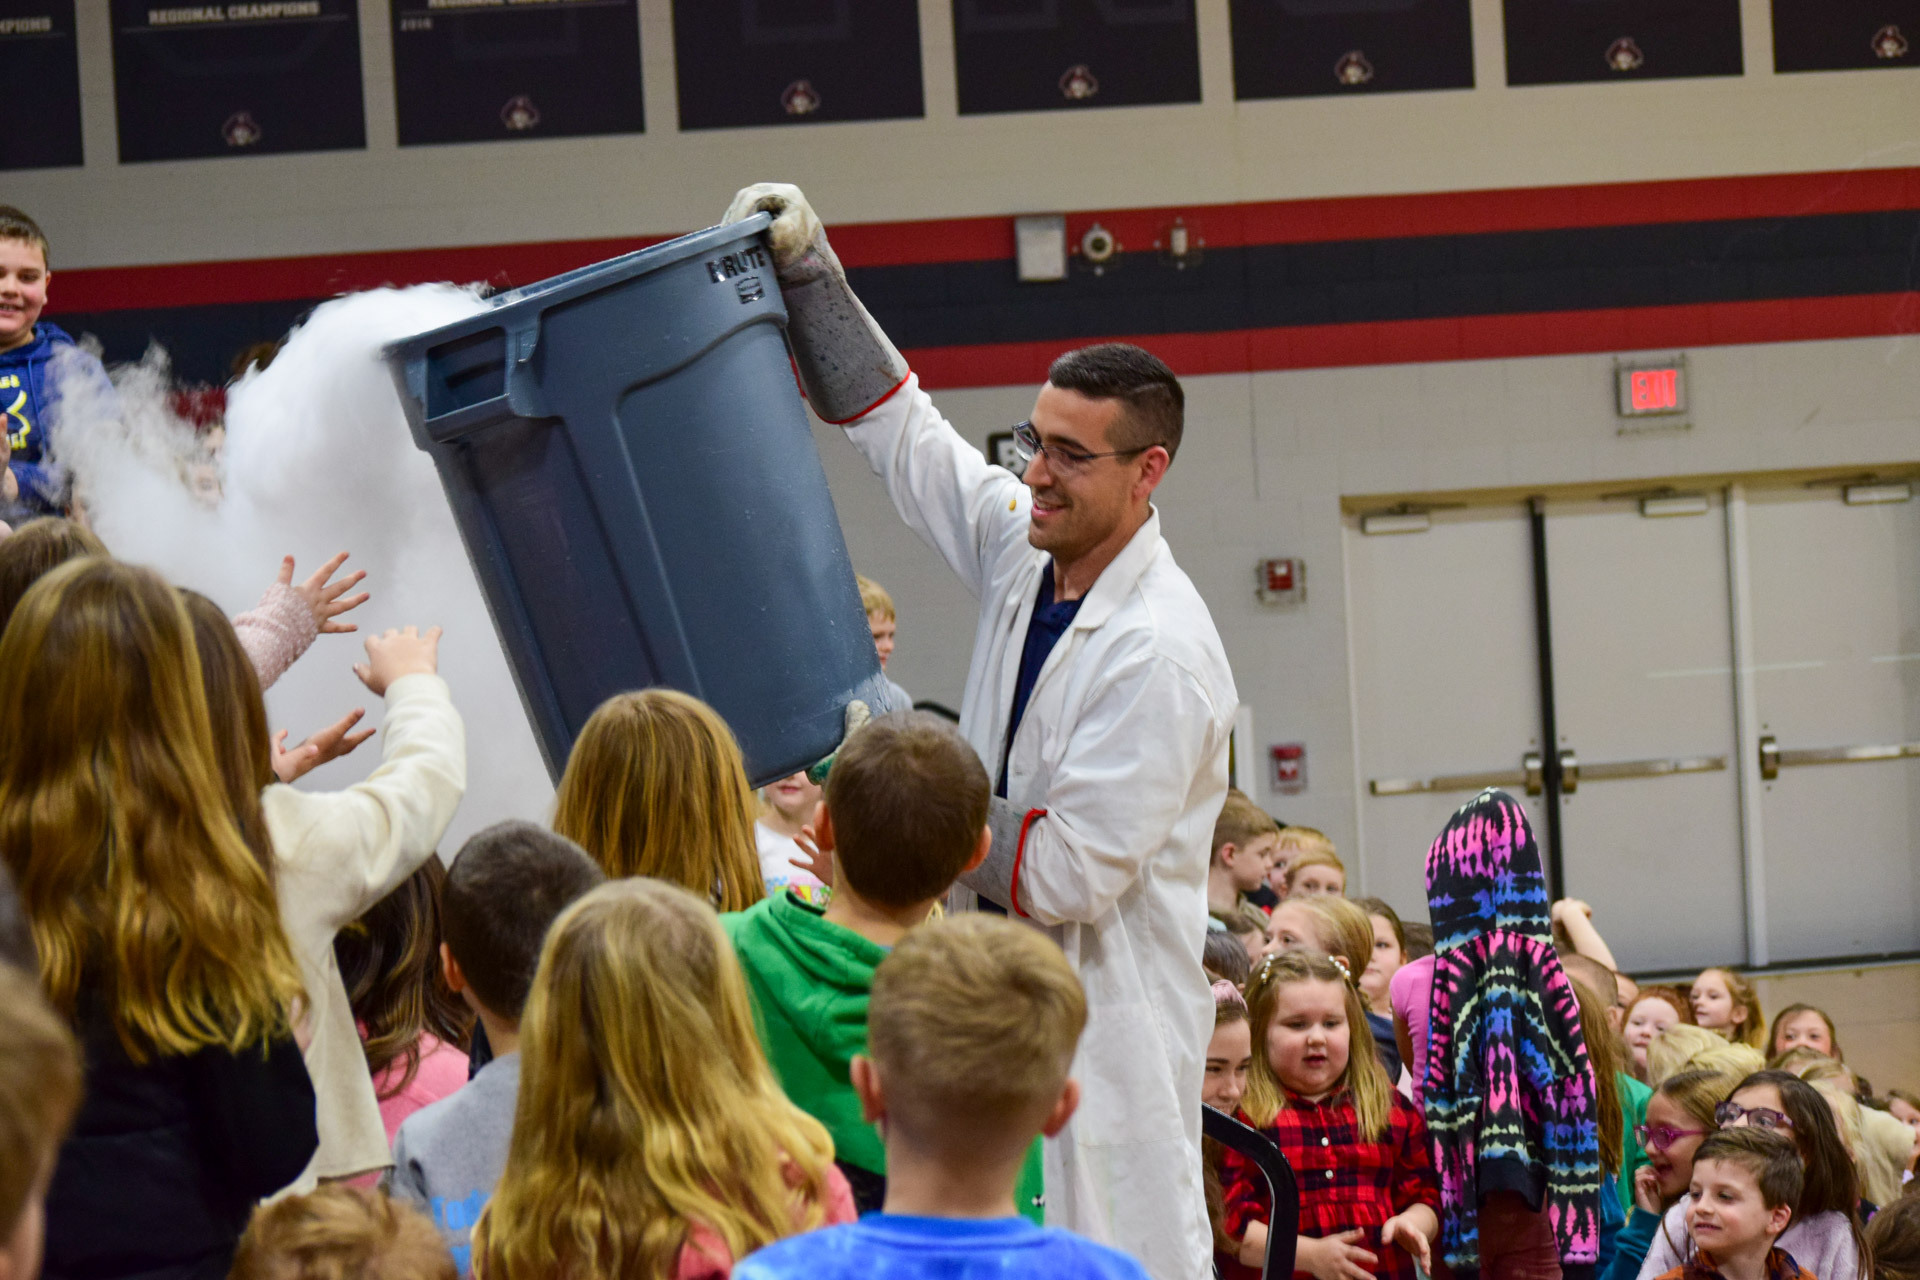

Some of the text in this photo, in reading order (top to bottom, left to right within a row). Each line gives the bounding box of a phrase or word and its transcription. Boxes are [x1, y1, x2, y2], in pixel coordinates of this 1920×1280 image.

[149, 1, 320, 25] REGIONAL CHAMPIONS
[1630, 369, 1677, 410] EXIT
